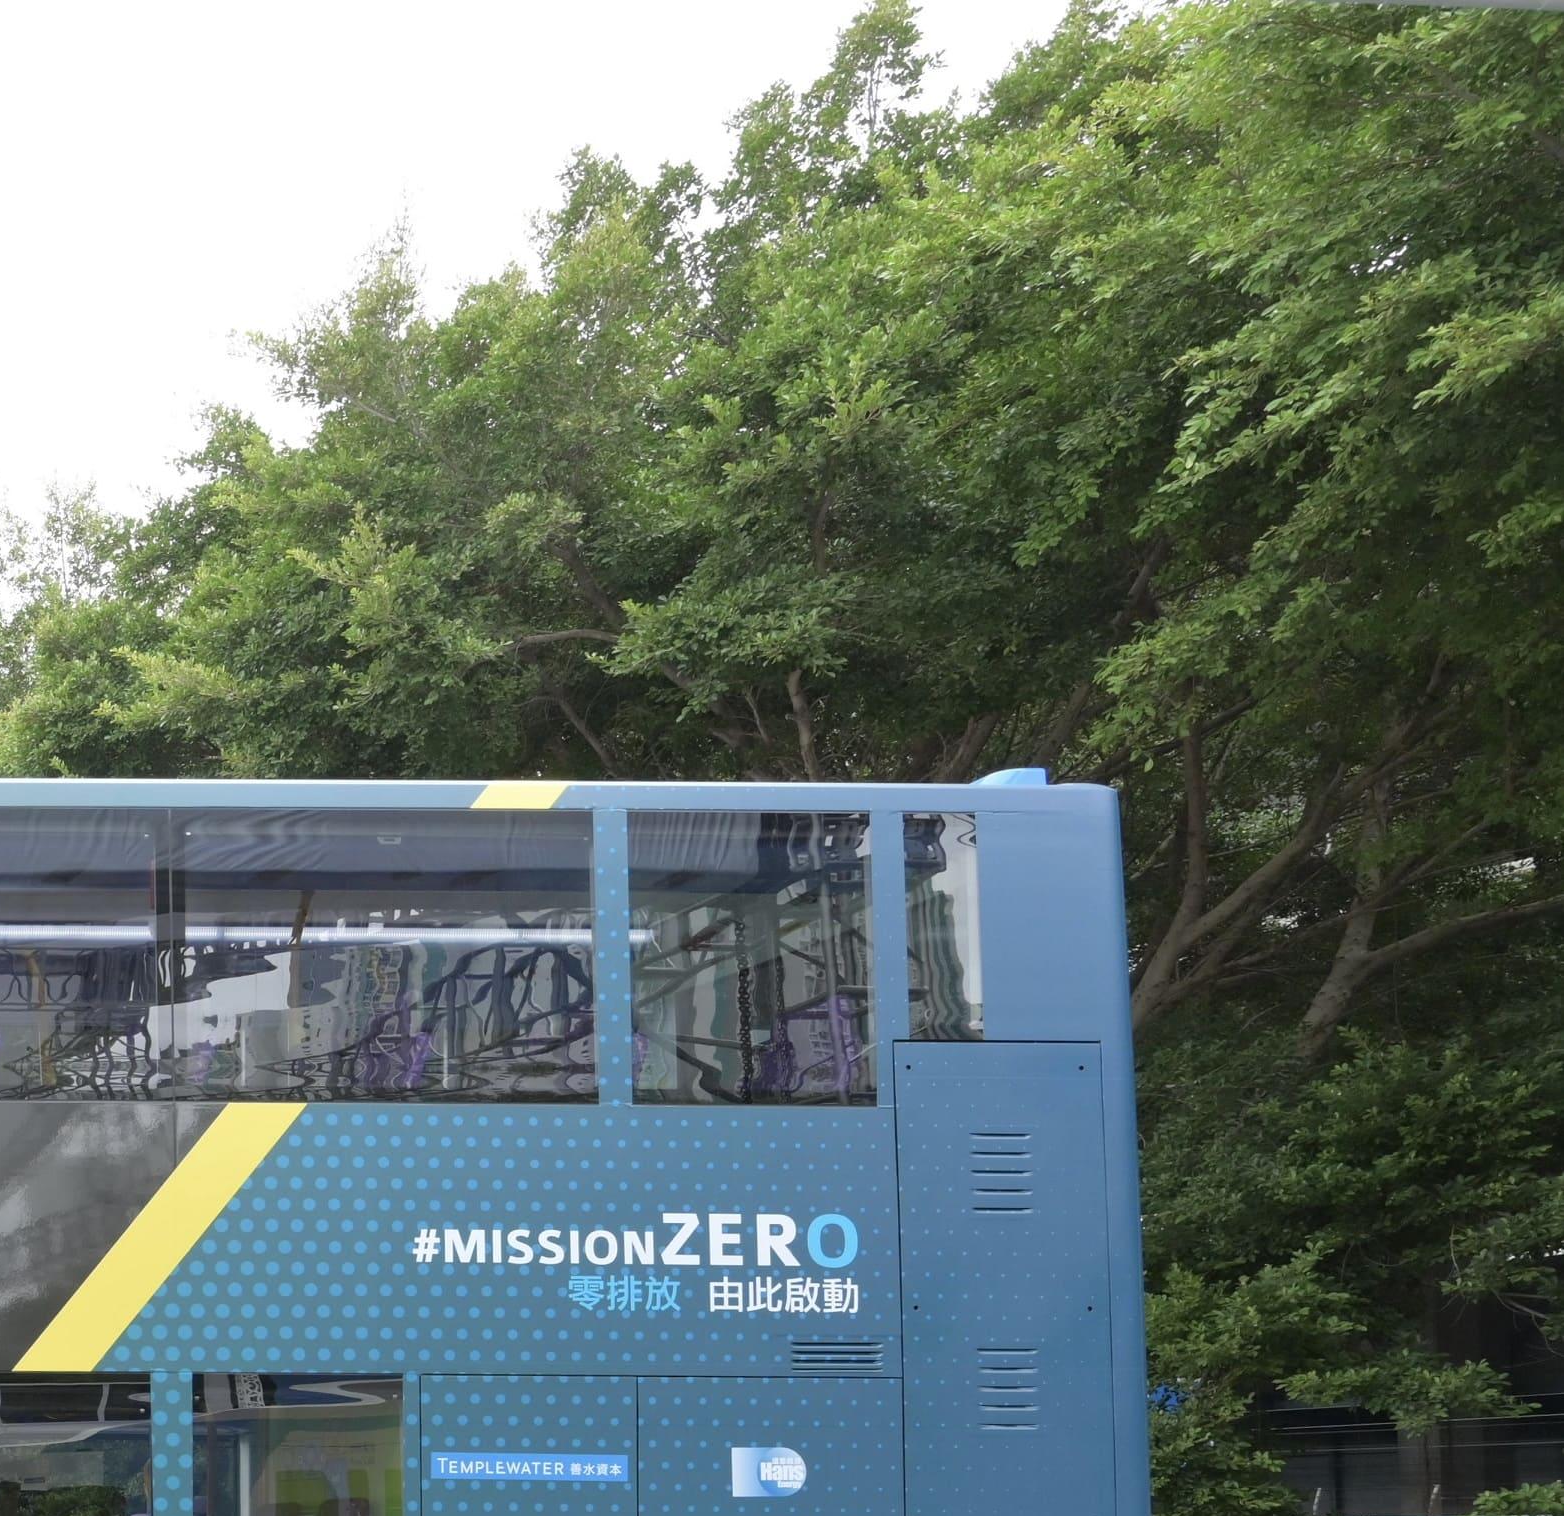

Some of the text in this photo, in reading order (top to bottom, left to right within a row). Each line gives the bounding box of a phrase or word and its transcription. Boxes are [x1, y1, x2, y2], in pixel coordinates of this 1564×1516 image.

[568, 1275, 682, 1312] 零排放
[570, 1463, 622, 1476] 善水資本
[760, 1462, 804, 1481] Hans
